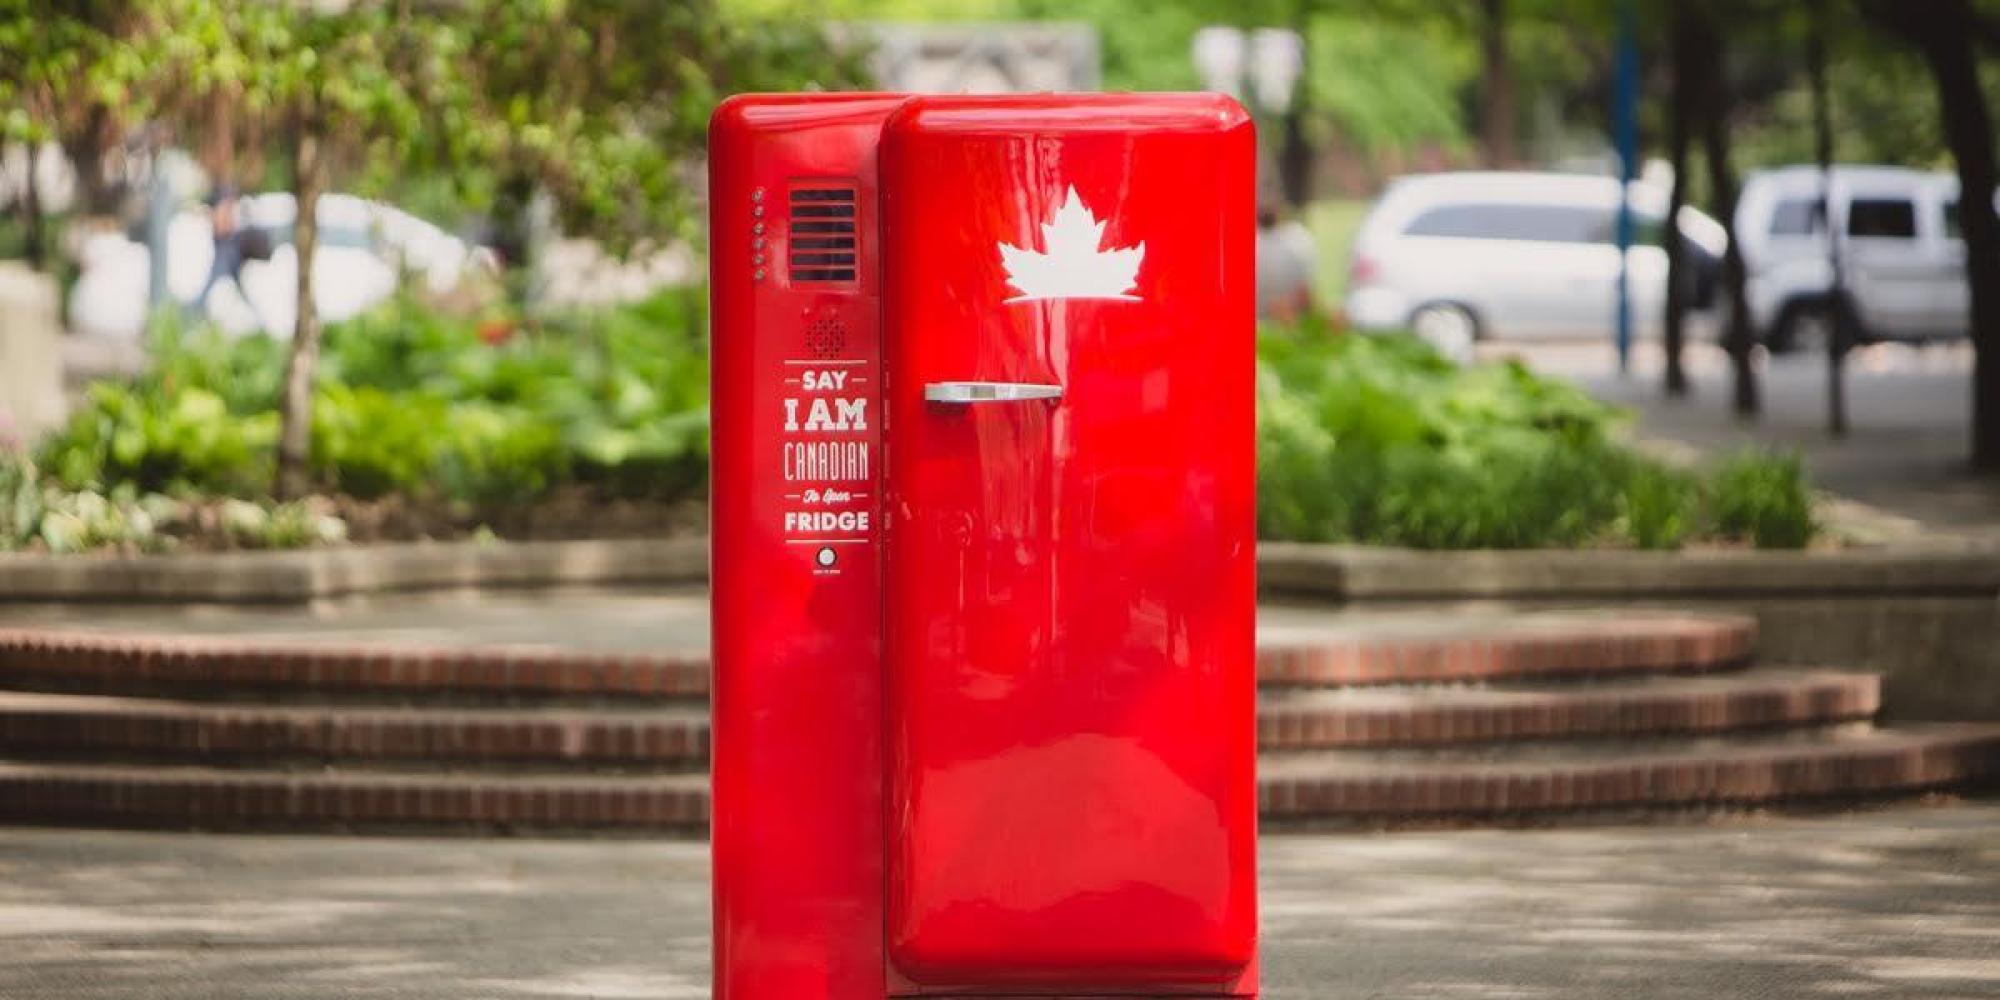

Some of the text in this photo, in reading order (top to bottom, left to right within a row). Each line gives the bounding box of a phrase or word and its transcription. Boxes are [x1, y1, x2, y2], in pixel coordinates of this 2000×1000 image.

[803, 371, 847, 390] SAY
[784, 398, 868, 432] I AM
[784, 442, 868, 481] CANADIAN
[803, 488, 850, 505] To Open
[784, 511, 869, 531] FRIDGE
